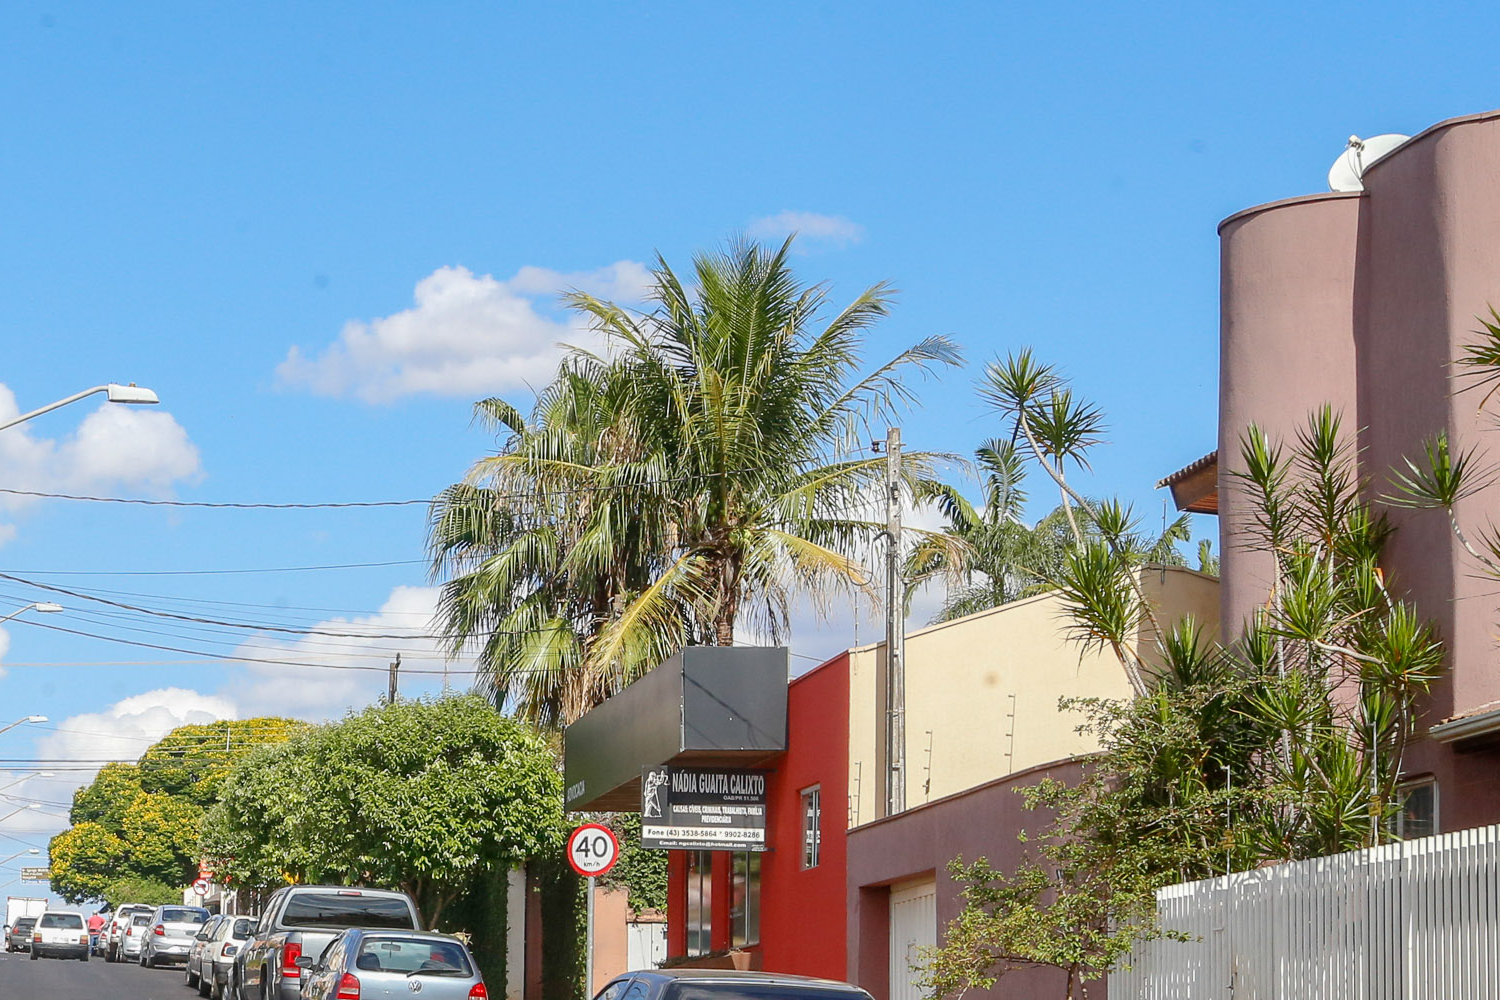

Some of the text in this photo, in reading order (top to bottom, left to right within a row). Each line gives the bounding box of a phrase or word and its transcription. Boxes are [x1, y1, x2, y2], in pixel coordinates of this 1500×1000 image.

[672, 769, 765, 795] NÁDIA GUAITA CALIXTO
[666, 829, 680, 837] (43)
[575, 836, 608, 858] 40
